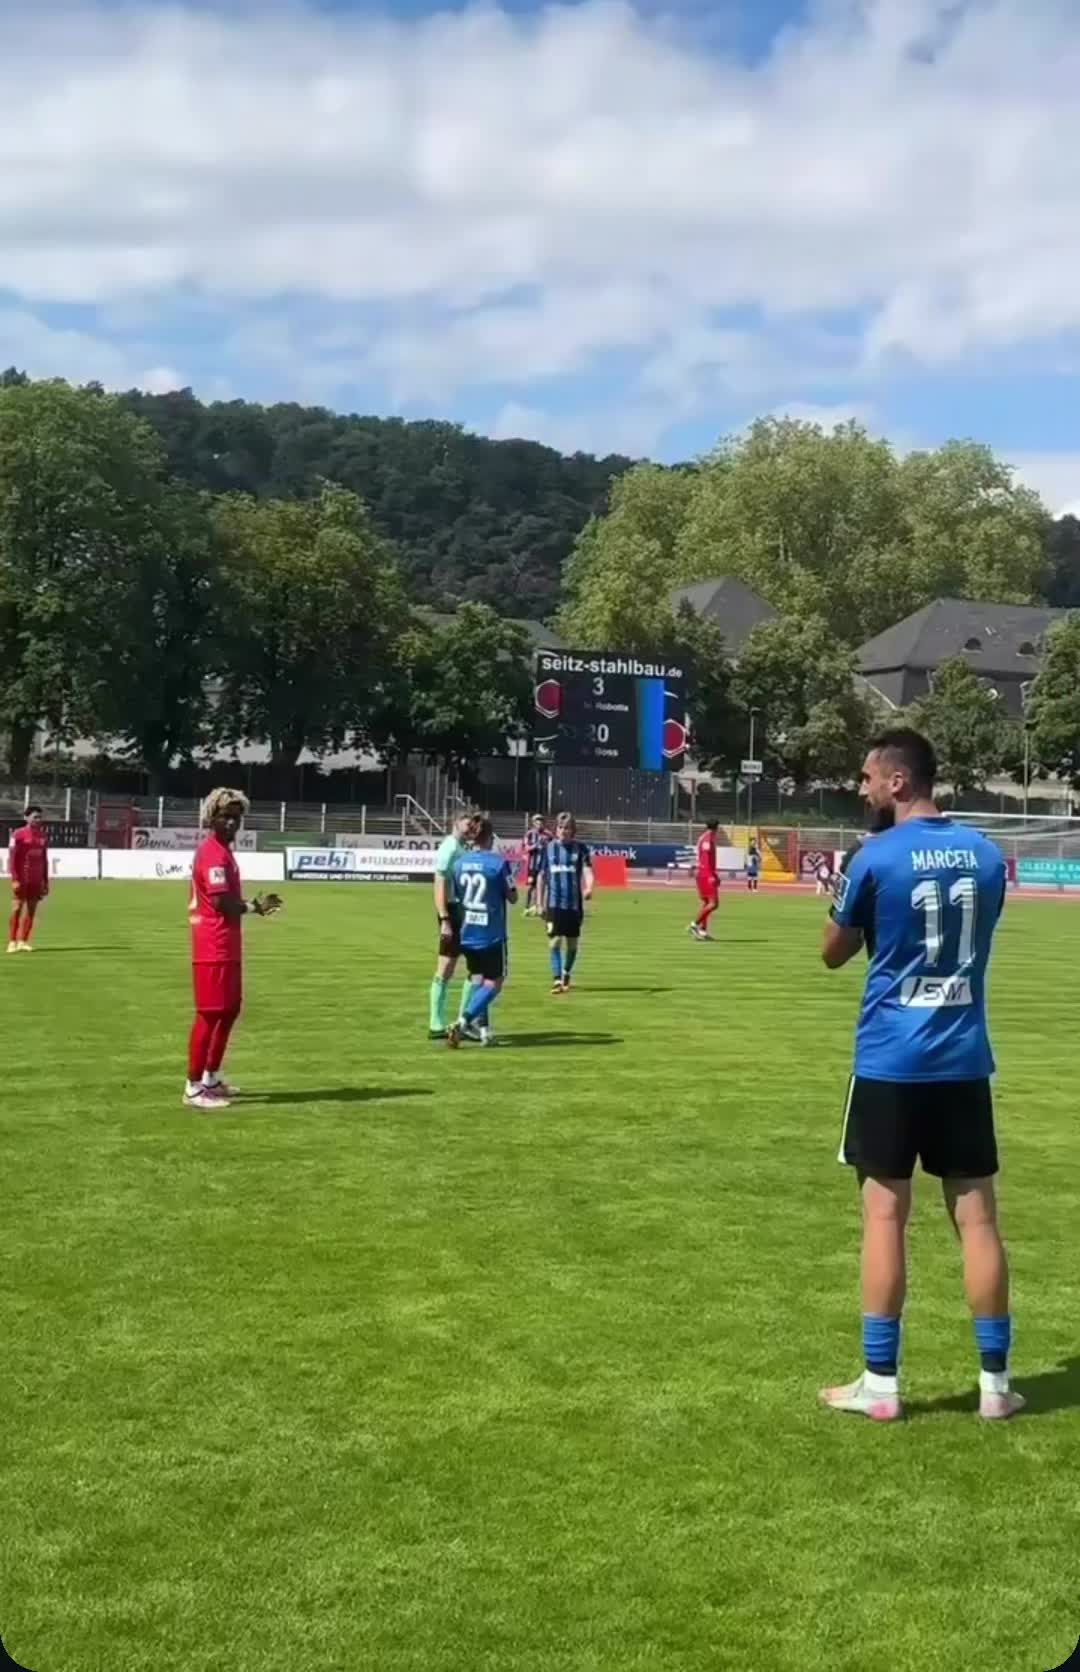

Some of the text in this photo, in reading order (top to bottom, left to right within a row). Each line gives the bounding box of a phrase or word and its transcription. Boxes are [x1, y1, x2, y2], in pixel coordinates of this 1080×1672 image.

[542, 656, 682, 677] seitz-stahlbau.de
[592, 678, 604, 695] 3
[298, 851, 349, 870] peki
[460, 873, 487, 911] 22
[911, 874, 977, 967] 11
